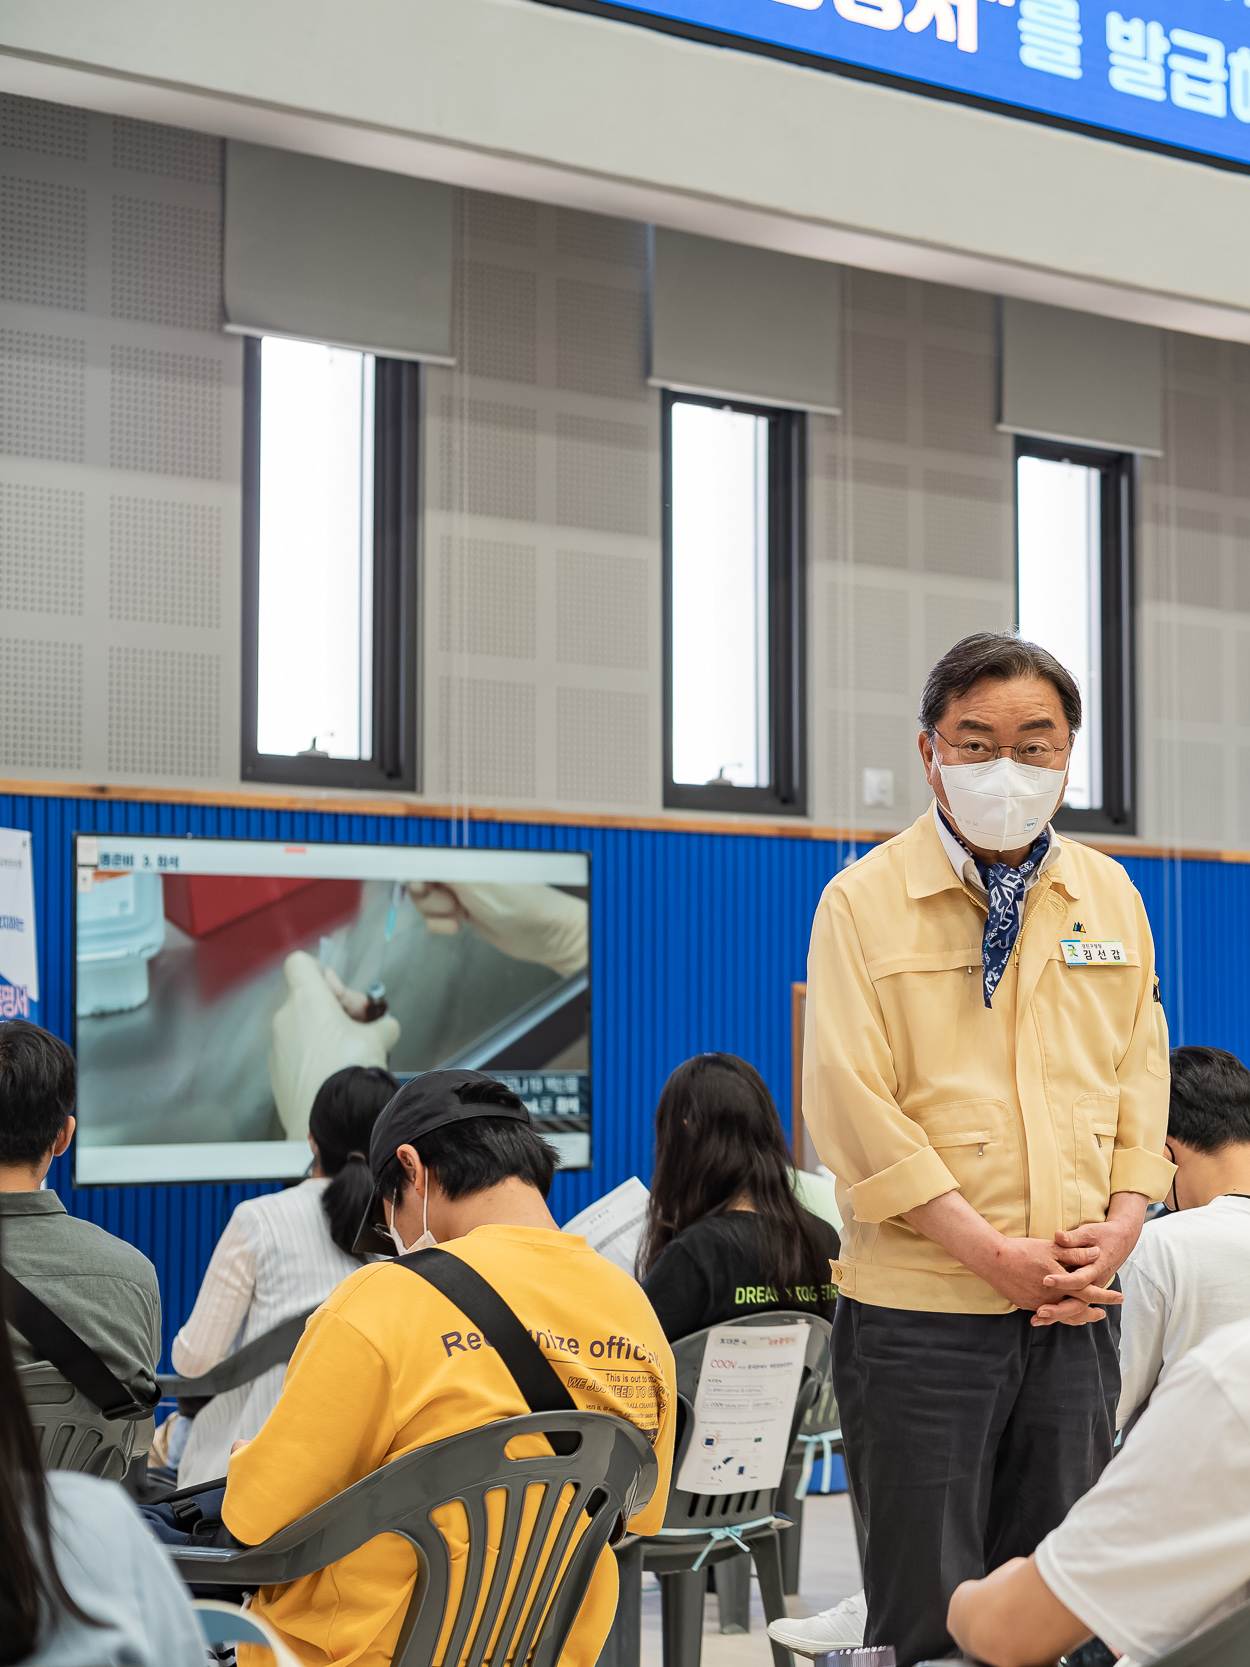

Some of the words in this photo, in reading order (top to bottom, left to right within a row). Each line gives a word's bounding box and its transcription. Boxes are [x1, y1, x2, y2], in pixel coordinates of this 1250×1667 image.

[0, 984, 31, 1018] 명서
[567, 1376, 588, 1389] WE
[605, 1373, 620, 1382] This
[623, 1374, 629, 1382] is
